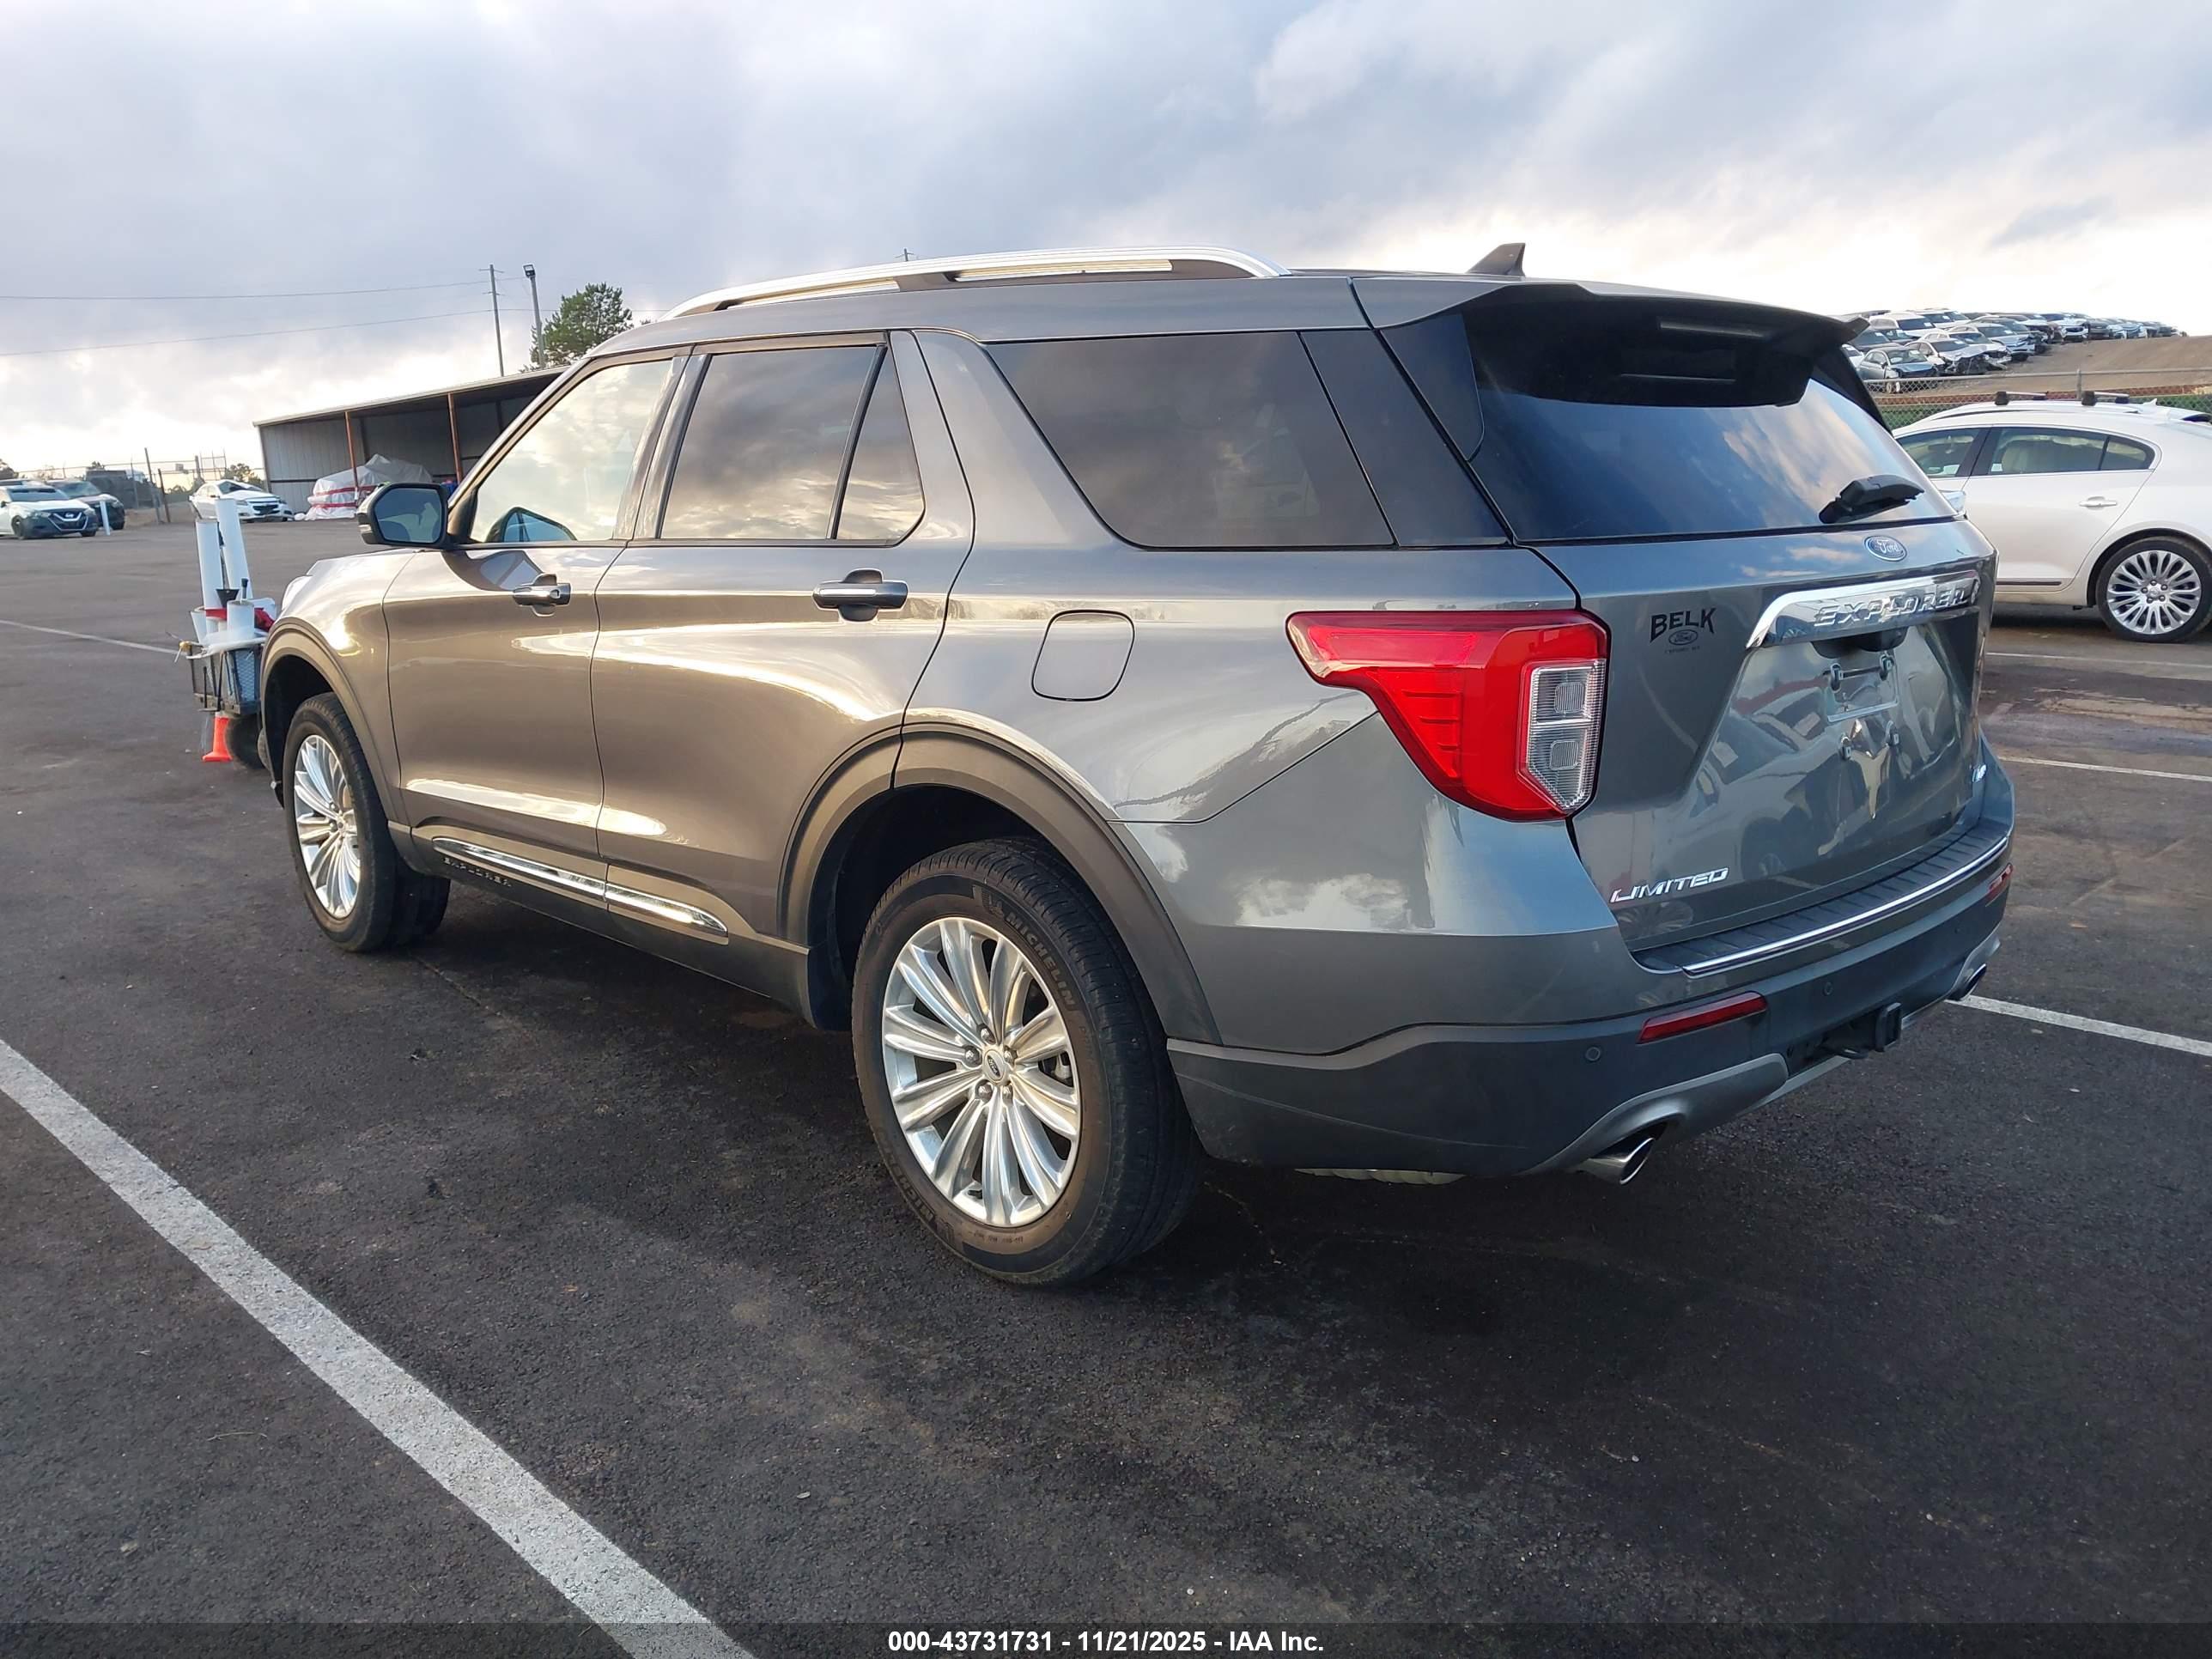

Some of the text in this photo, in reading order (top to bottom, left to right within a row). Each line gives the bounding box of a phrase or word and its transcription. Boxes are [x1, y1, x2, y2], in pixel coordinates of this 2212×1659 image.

[1876, 538, 1902, 554] Ford
[1649, 607, 1717, 643] BELK
[1814, 588, 1967, 627] EXPLORER
[1609, 867, 1729, 902] LIMITED
[1006, 911, 1078, 1011] MICHELIN
